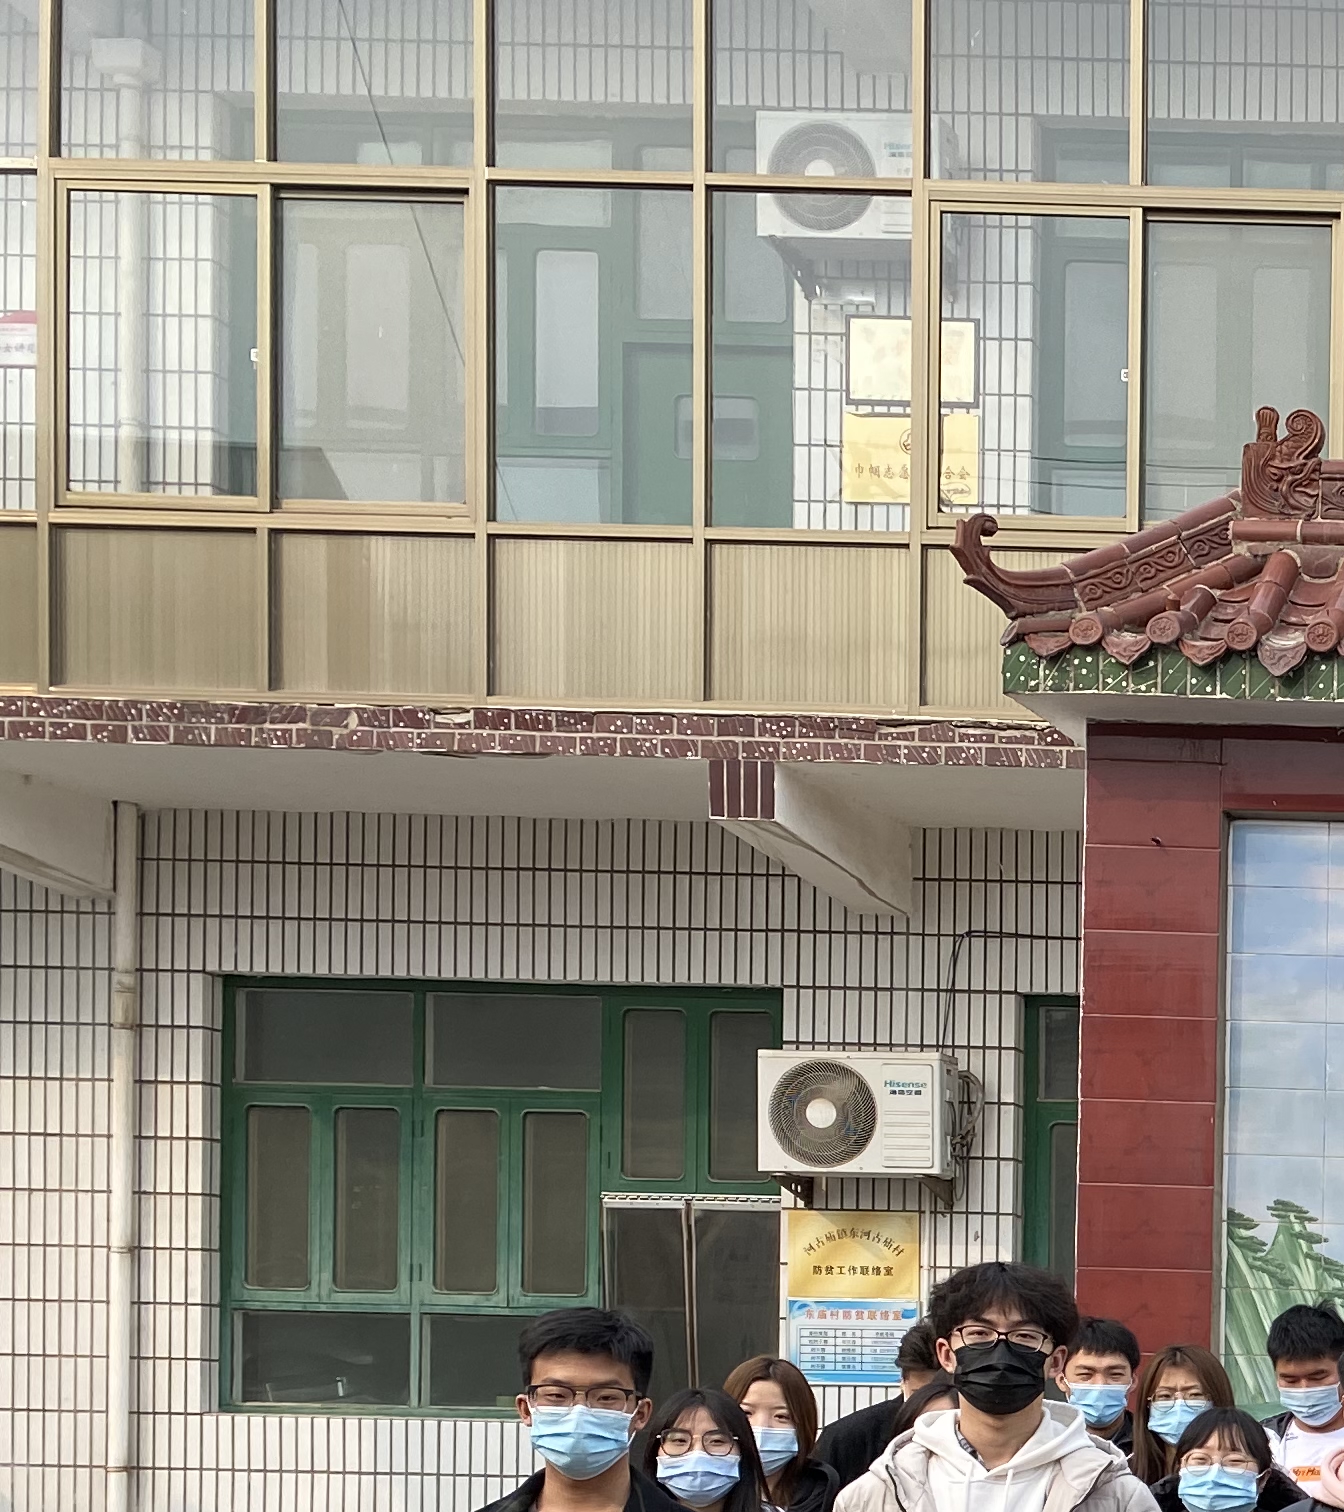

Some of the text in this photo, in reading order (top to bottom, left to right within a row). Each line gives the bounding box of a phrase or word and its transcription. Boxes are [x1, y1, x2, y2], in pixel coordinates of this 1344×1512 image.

[855, 463, 970, 480] 巾帼志愿合会
[884, 1080, 927, 1088] Hisense
[812, 1265, 894, 1277] 防贫工作联络室
[805, 1308, 902, 1321] 东庙村防贫联络室
